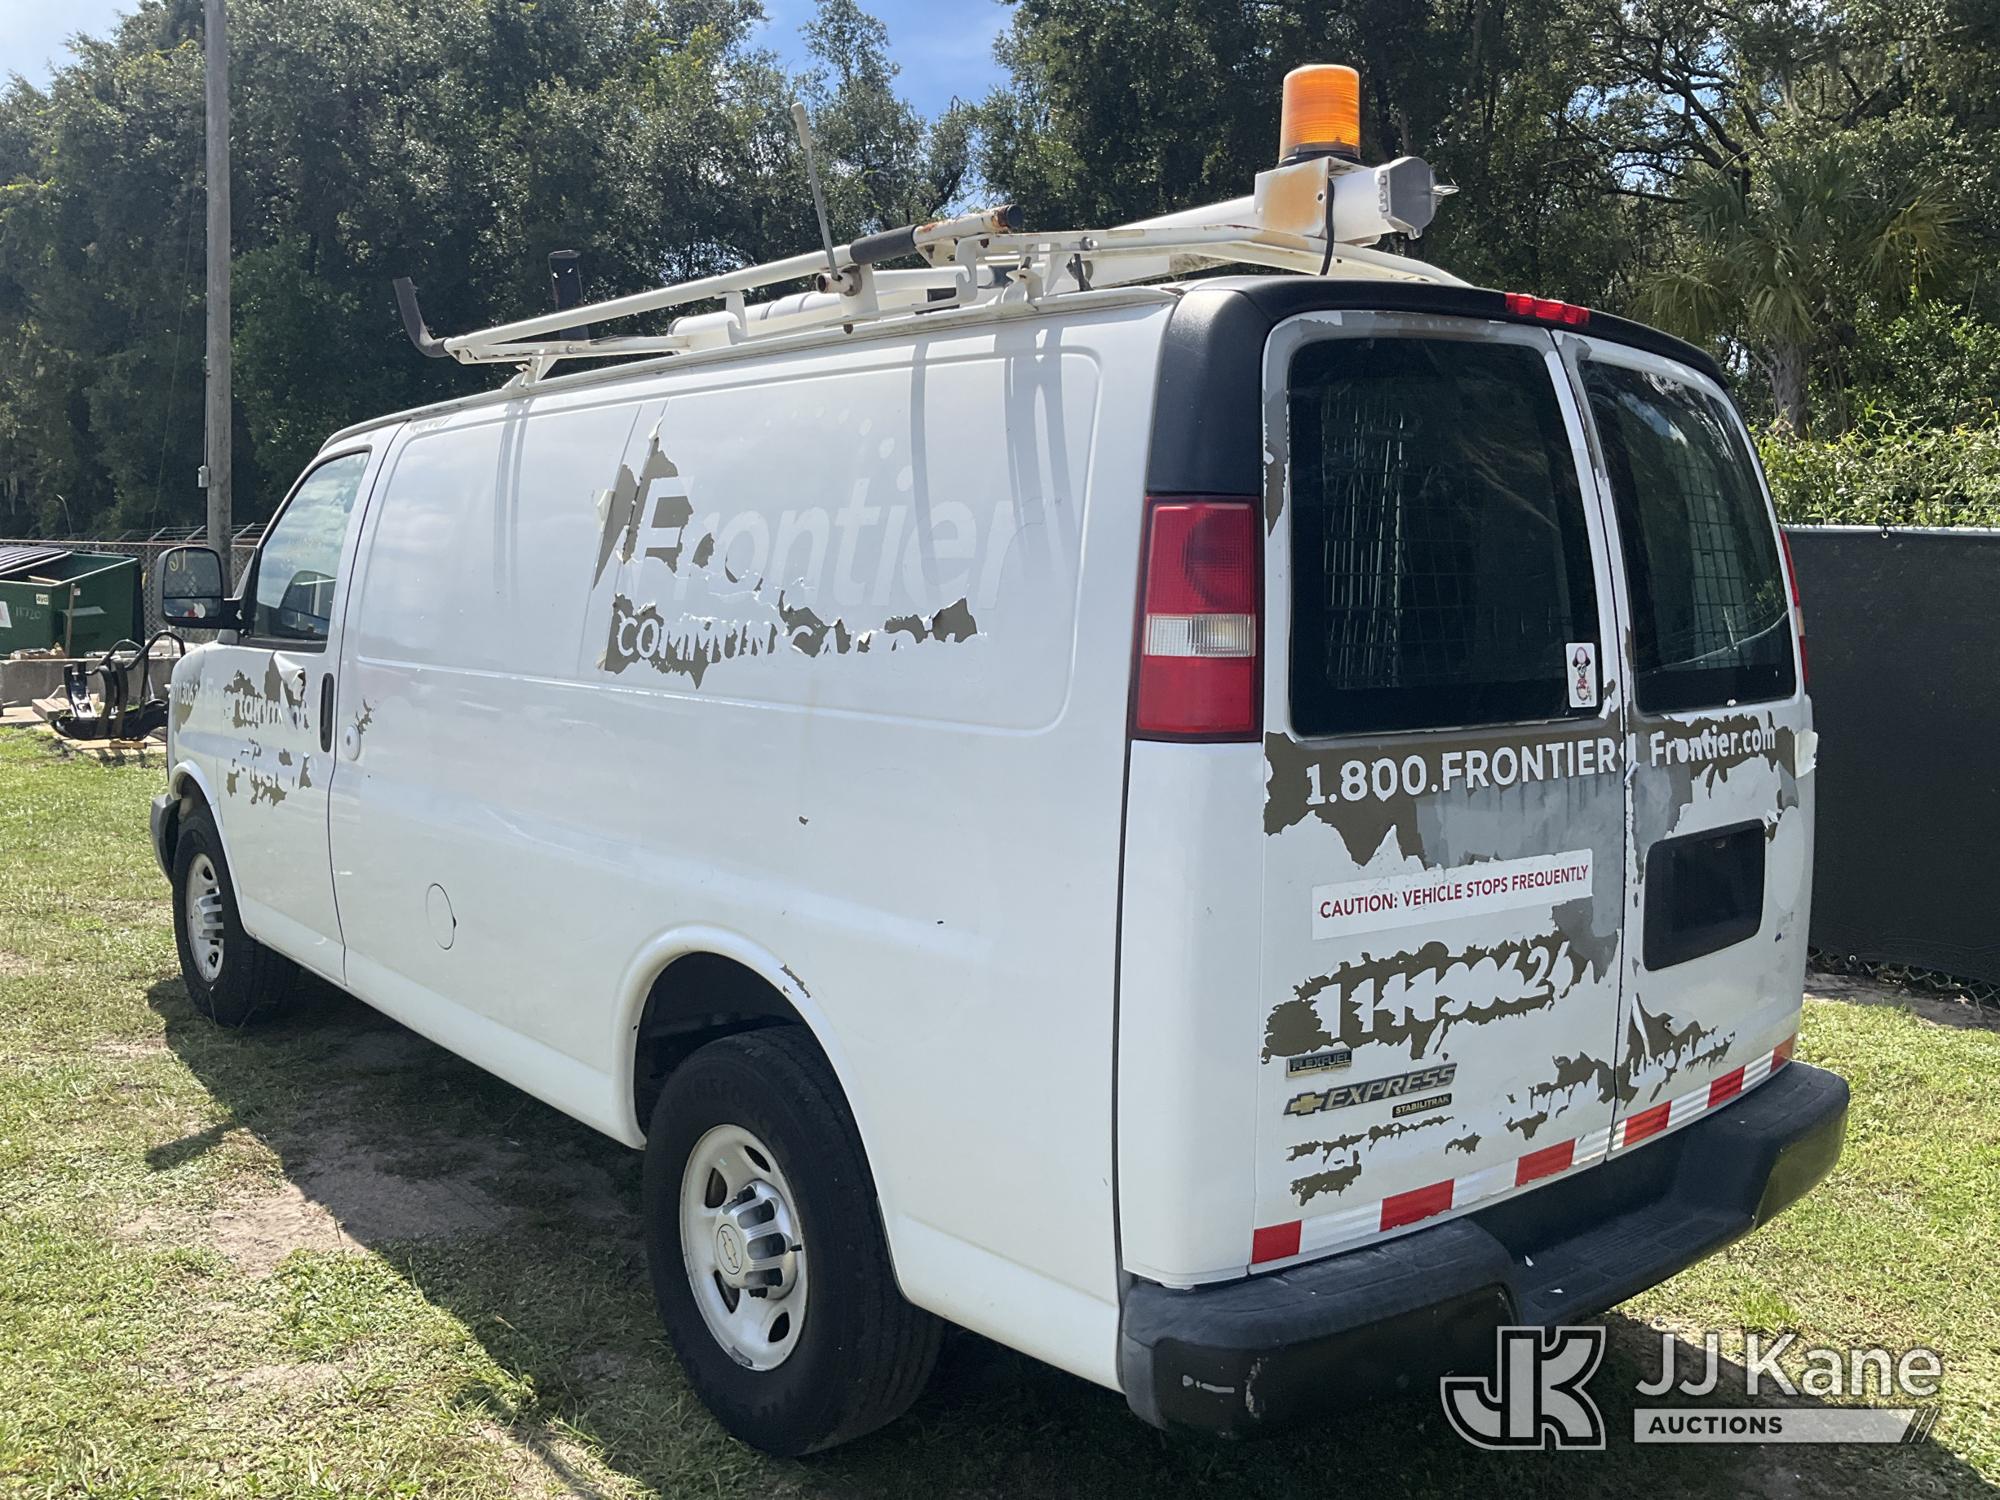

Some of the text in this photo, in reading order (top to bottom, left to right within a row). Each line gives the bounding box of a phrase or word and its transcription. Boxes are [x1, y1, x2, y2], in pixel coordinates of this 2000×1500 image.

[632, 465, 1022, 610] Frontier
[1649, 725, 1776, 767] Frontier.com
[1305, 737, 1616, 806] 1.800.FRONTIER
[1319, 864, 1589, 919] CAUTION: VEHICLE STOPS FREQUENTLY
[1291, 1052, 1349, 1072] FLEXFUEL
[1324, 1066, 1457, 1110] EXPRESS
[1395, 1096, 1450, 1115] STABILITRAK
